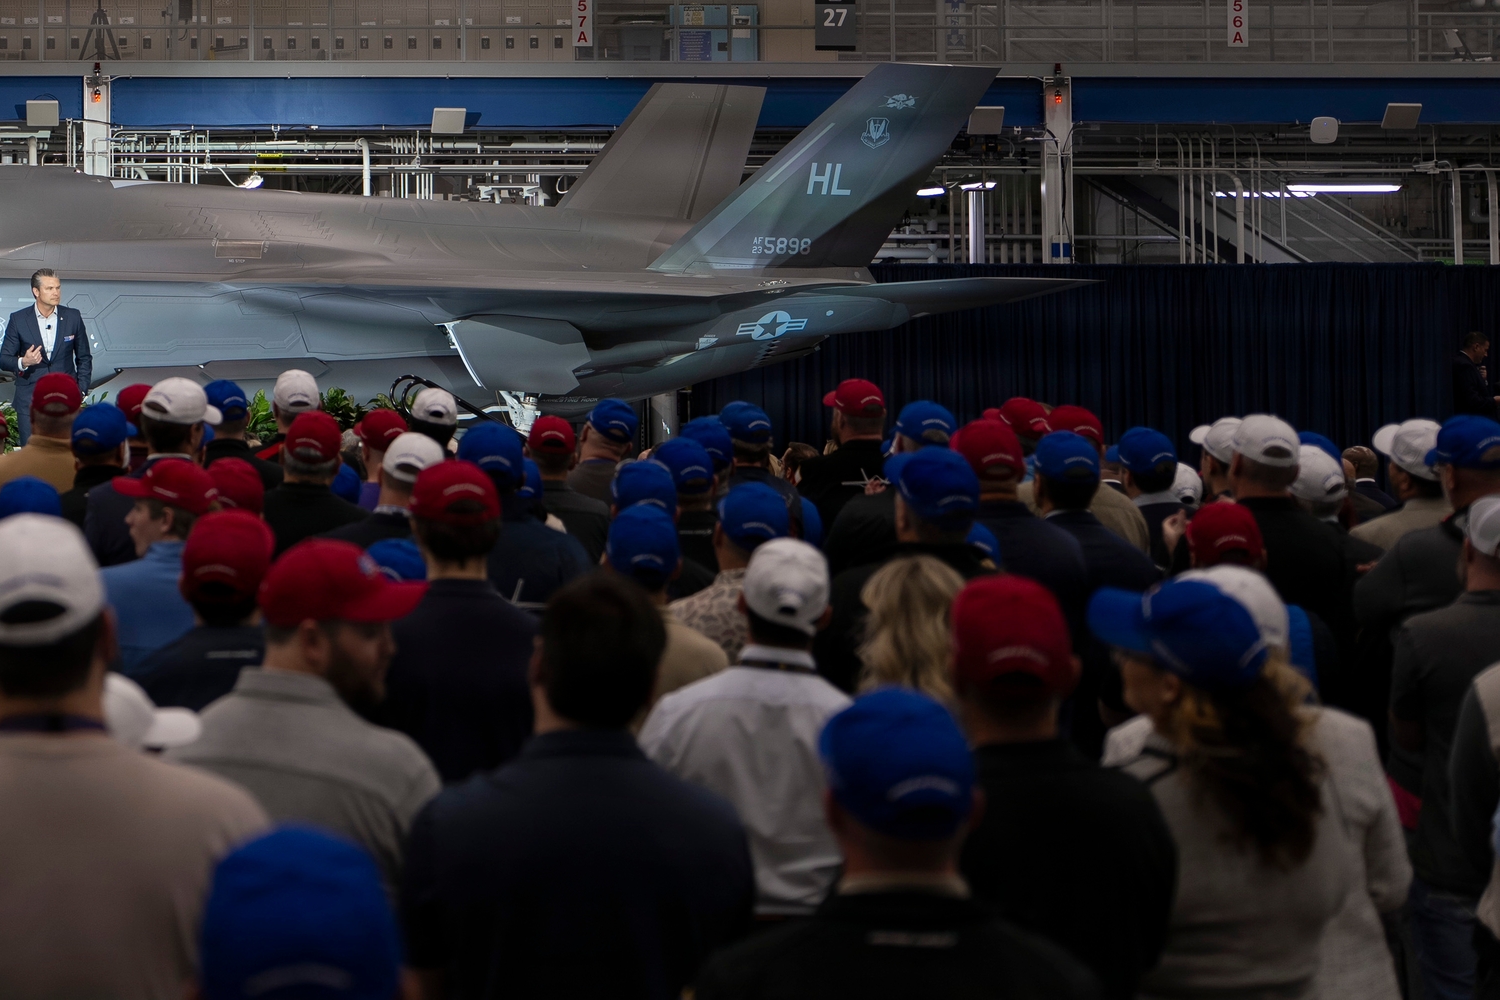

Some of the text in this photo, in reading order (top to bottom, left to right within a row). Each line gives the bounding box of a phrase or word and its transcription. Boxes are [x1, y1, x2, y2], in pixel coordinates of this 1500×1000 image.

[823, 8, 848, 27] 27
[806, 162, 852, 196] HL
[751, 246, 762, 254] 23
[752, 236, 812, 255] AF 5898
